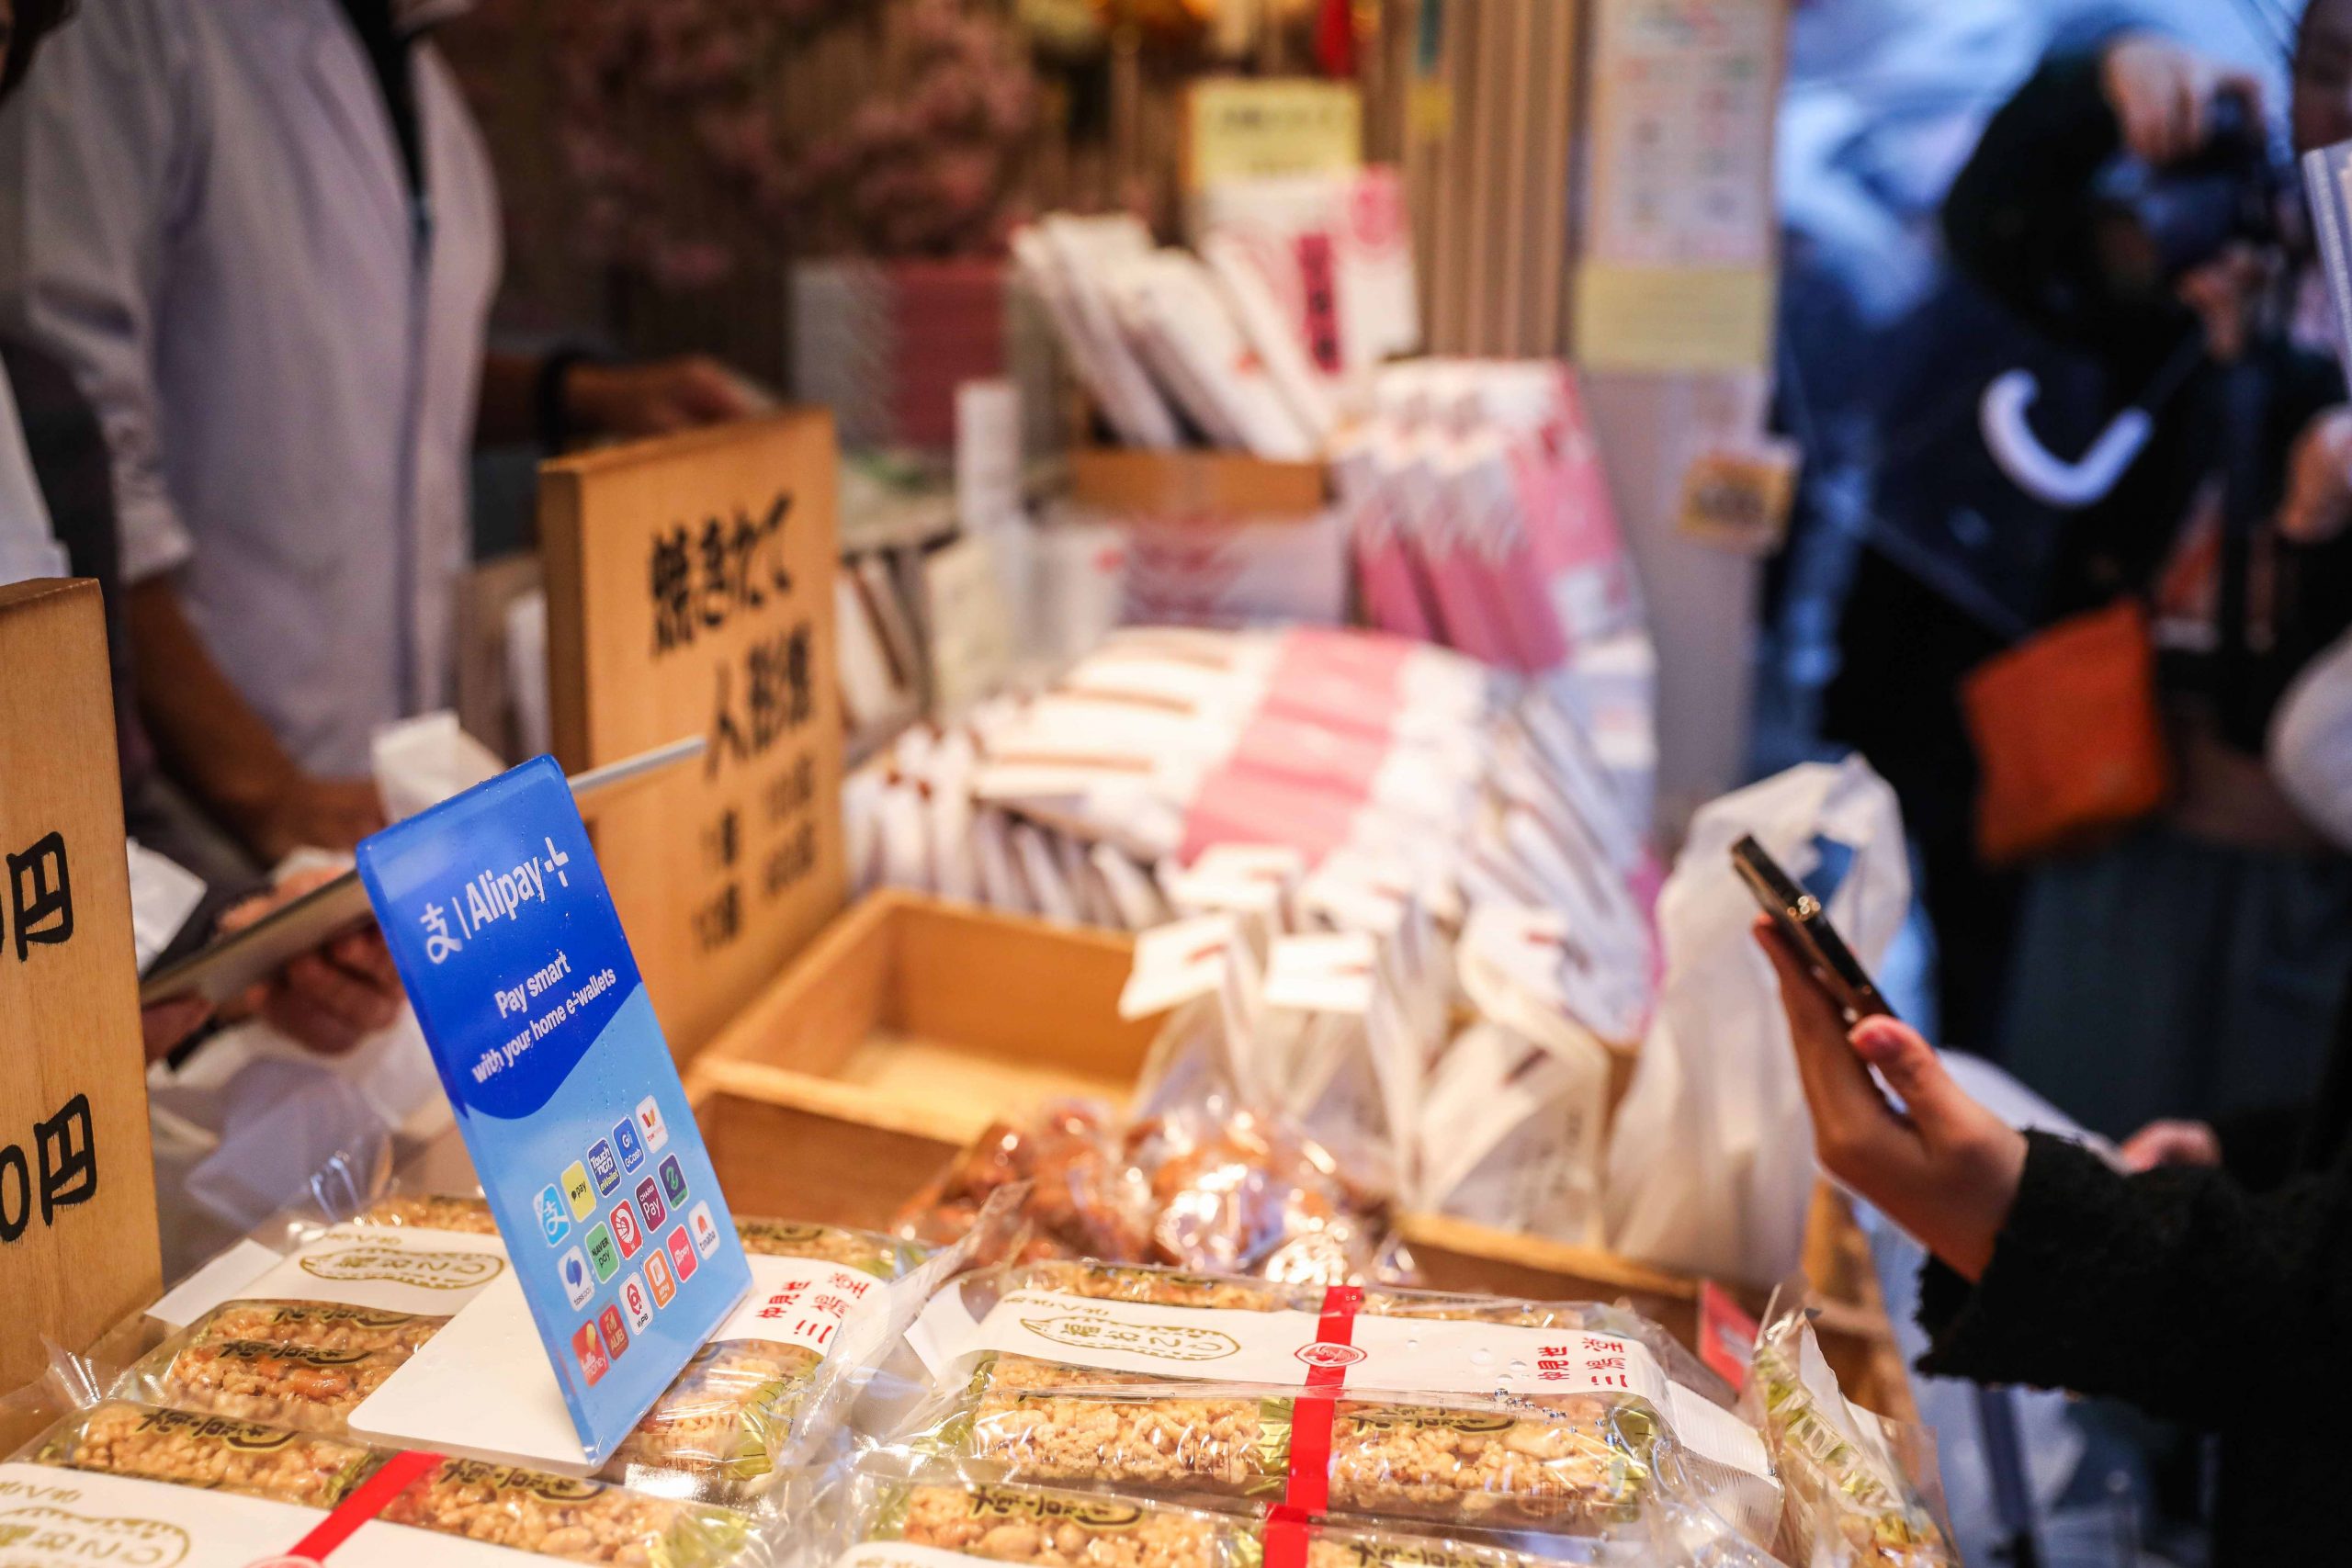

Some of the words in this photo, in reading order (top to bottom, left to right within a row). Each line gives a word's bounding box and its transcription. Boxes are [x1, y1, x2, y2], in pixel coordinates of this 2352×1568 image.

[0, 831, 74, 962] 円
[493, 985, 527, 1018] Pay
[527, 951, 571, 998] smart
[472, 1049, 505, 1084] with
[503, 1028, 532, 1067] your
[530, 1005, 566, 1041] home
[566, 966, 616, 1015] e-wallets
[590, 1146, 610, 1168] Touch
[625, 1147, 642, 1168] GCash
[600, 1168, 619, 1191] eWallet
[642, 1198, 661, 1221] Pay
[592, 1237, 610, 1257] NAVER
[598, 1250, 611, 1269] pay
[610, 1328, 625, 1351] AUB
